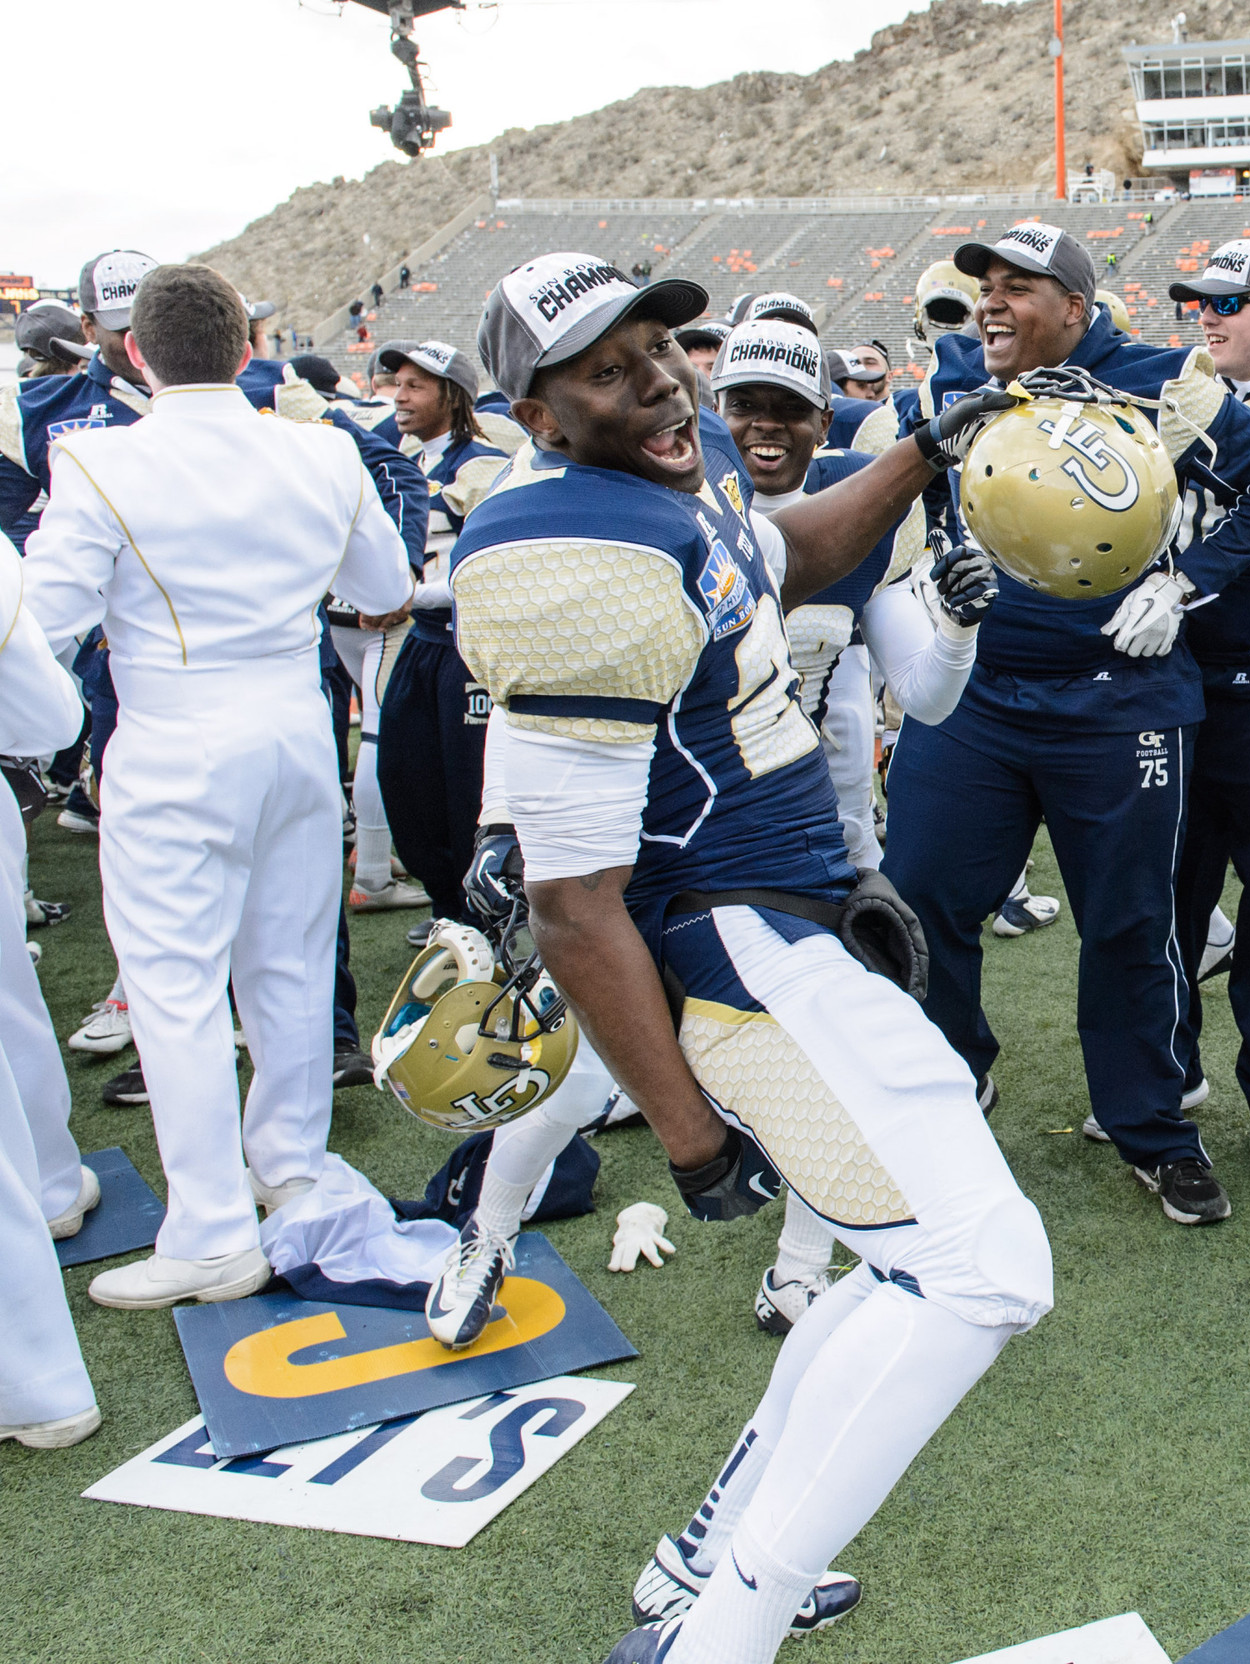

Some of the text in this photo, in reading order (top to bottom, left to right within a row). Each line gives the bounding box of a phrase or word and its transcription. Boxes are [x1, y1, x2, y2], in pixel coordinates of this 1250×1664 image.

[528, 277, 559, 304] SUN
[794, 343, 818, 359] 2012
[730, 344, 818, 378] CHAMPIONS
[715, 617, 736, 636] SUN
[1138, 731, 1165, 748] GT
[1135, 747, 1169, 758] FOOTBALL
[1139, 758, 1168, 788] 75
